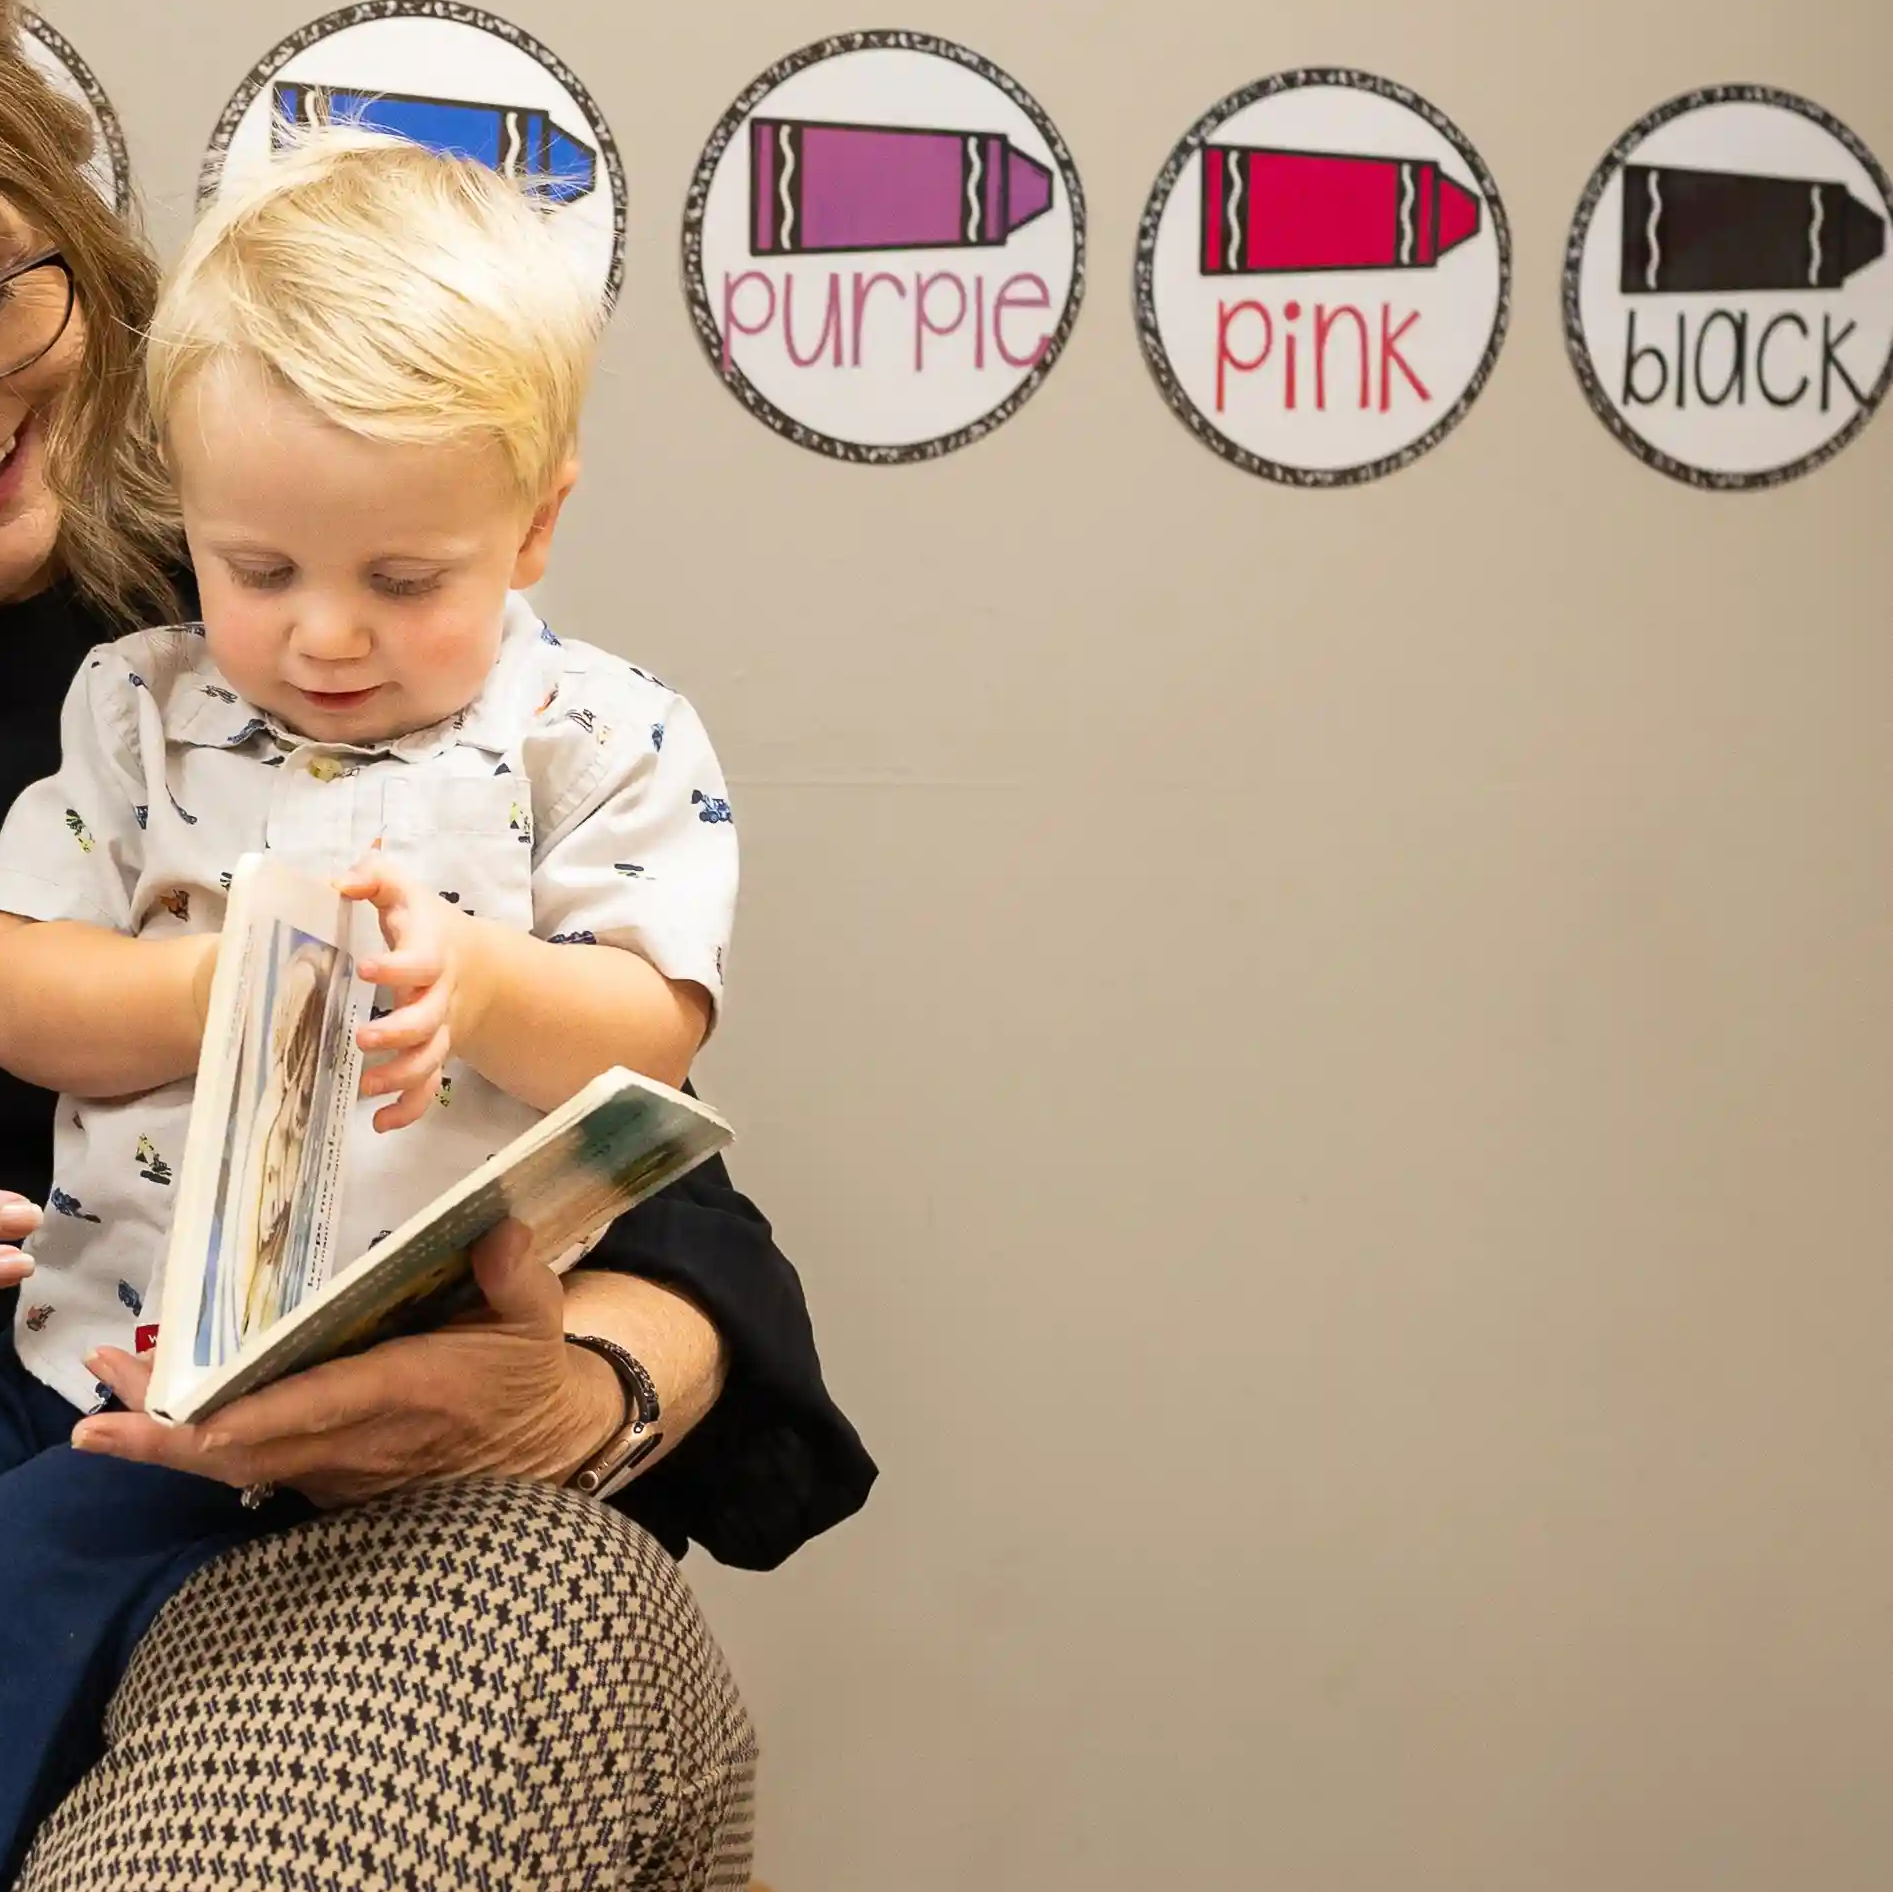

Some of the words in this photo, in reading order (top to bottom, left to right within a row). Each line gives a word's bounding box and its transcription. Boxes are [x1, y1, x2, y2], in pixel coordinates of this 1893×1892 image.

[722, 270, 1052, 372] purple
[1214, 298, 1433, 414] pink
[1621, 307, 1872, 408] black
